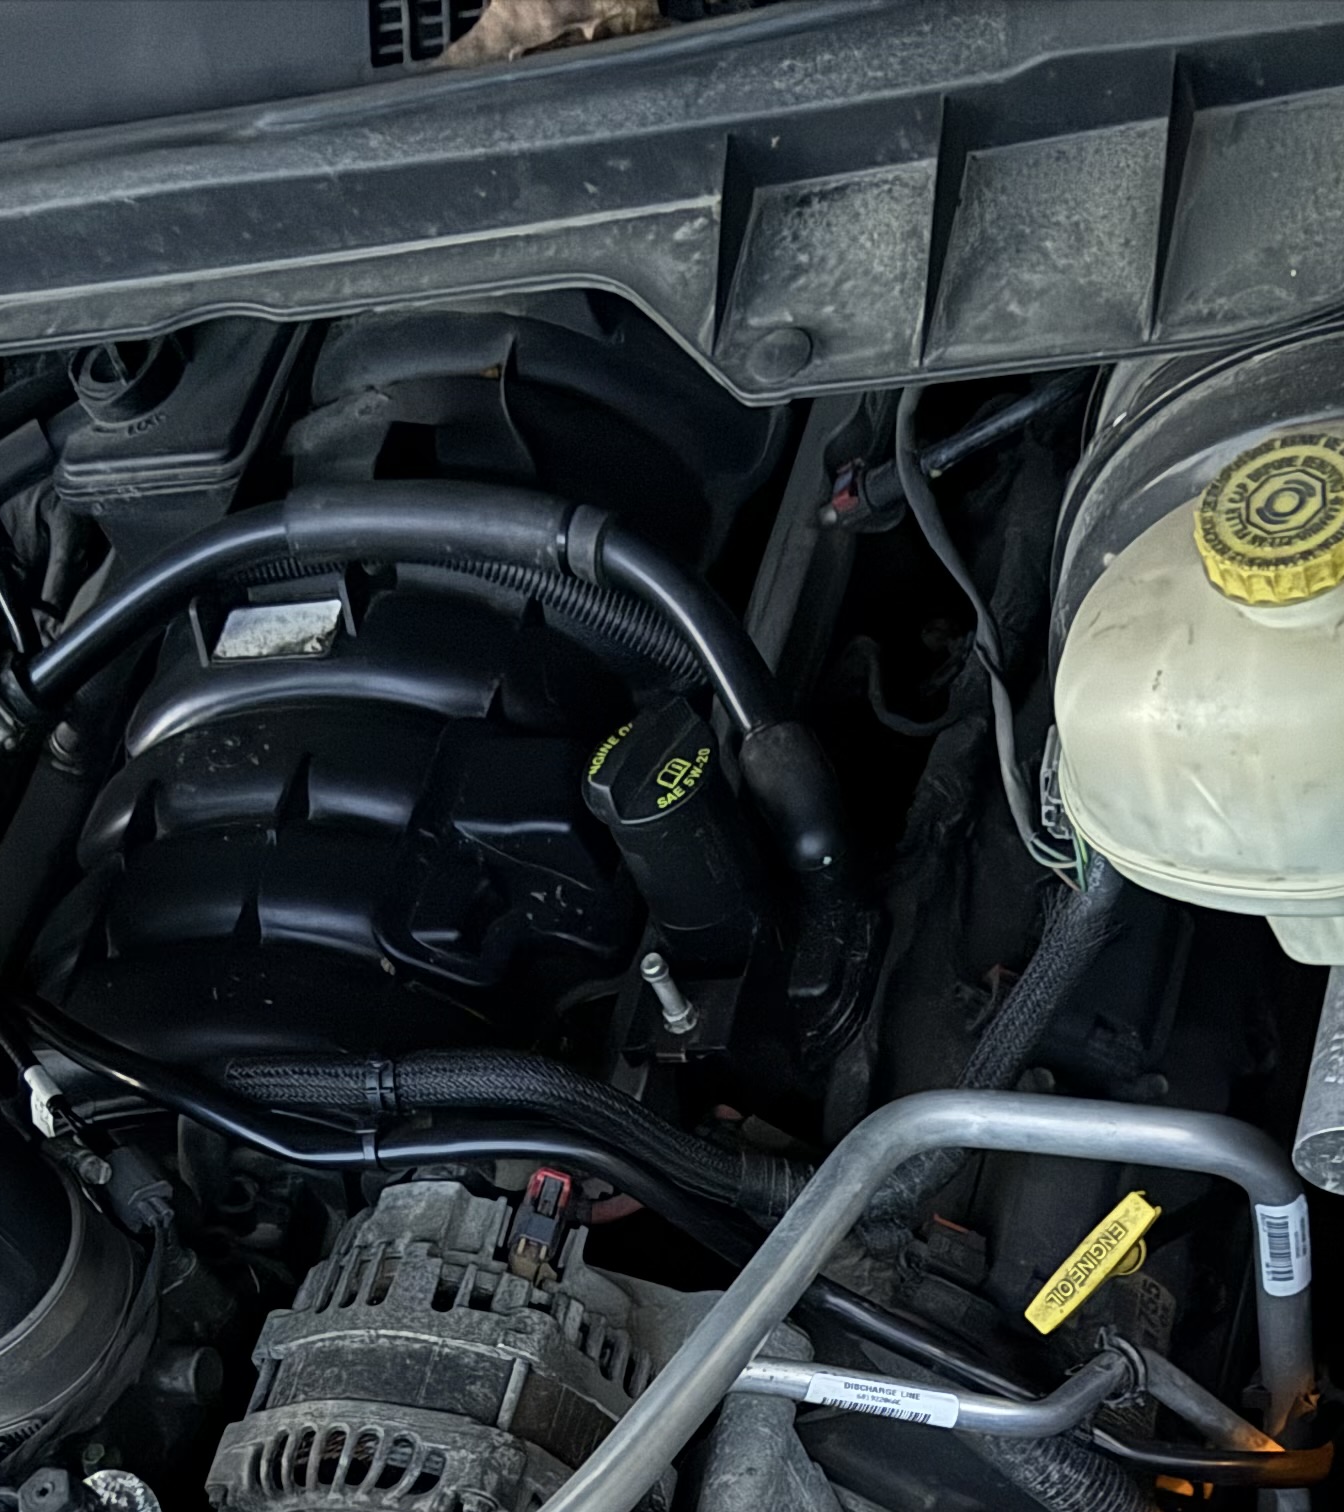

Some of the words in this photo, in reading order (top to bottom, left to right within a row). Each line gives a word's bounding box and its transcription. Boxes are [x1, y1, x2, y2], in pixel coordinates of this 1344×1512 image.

[657, 786, 686, 809] SAE
[683, 748, 711, 787] 5W-20
[1066, 1220, 1127, 1290] ENGINE
[1045, 1278, 1075, 1306] OIL
[844, 1382, 897, 1397] DISCHARGE
[901, 1391, 921, 1400] LINE
